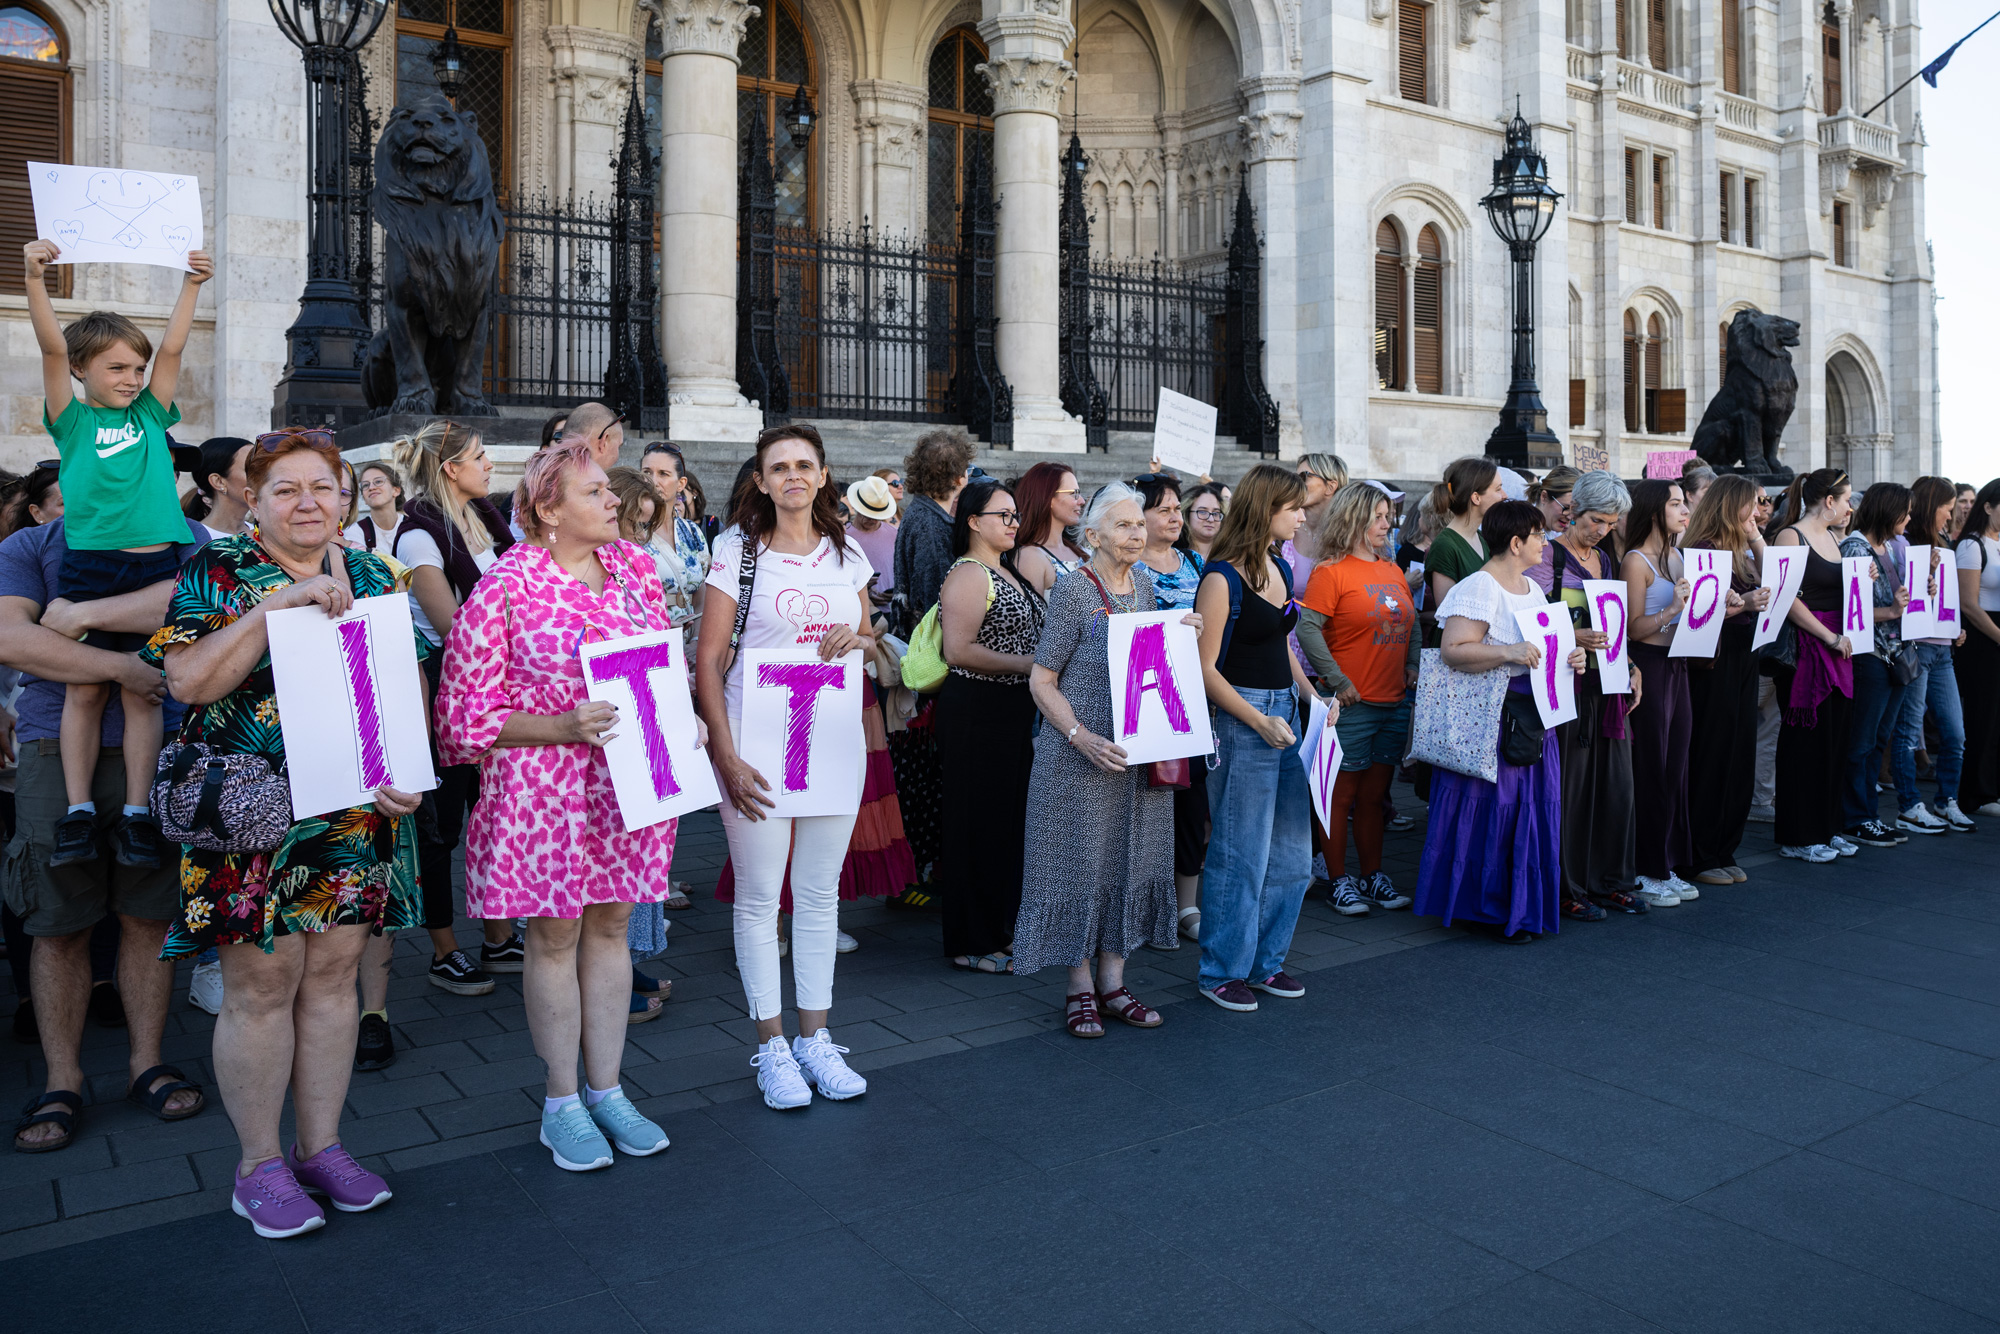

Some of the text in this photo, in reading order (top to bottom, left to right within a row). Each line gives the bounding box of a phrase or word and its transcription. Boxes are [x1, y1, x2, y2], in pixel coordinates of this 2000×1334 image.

[95, 422, 139, 445] NIKE
[1363, 583, 1403, 598] MICKEY
[1372, 630, 1409, 645] MOUSE
[1122, 622, 1193, 741] A
[588, 641, 683, 803] T
[757, 662, 847, 795] T
